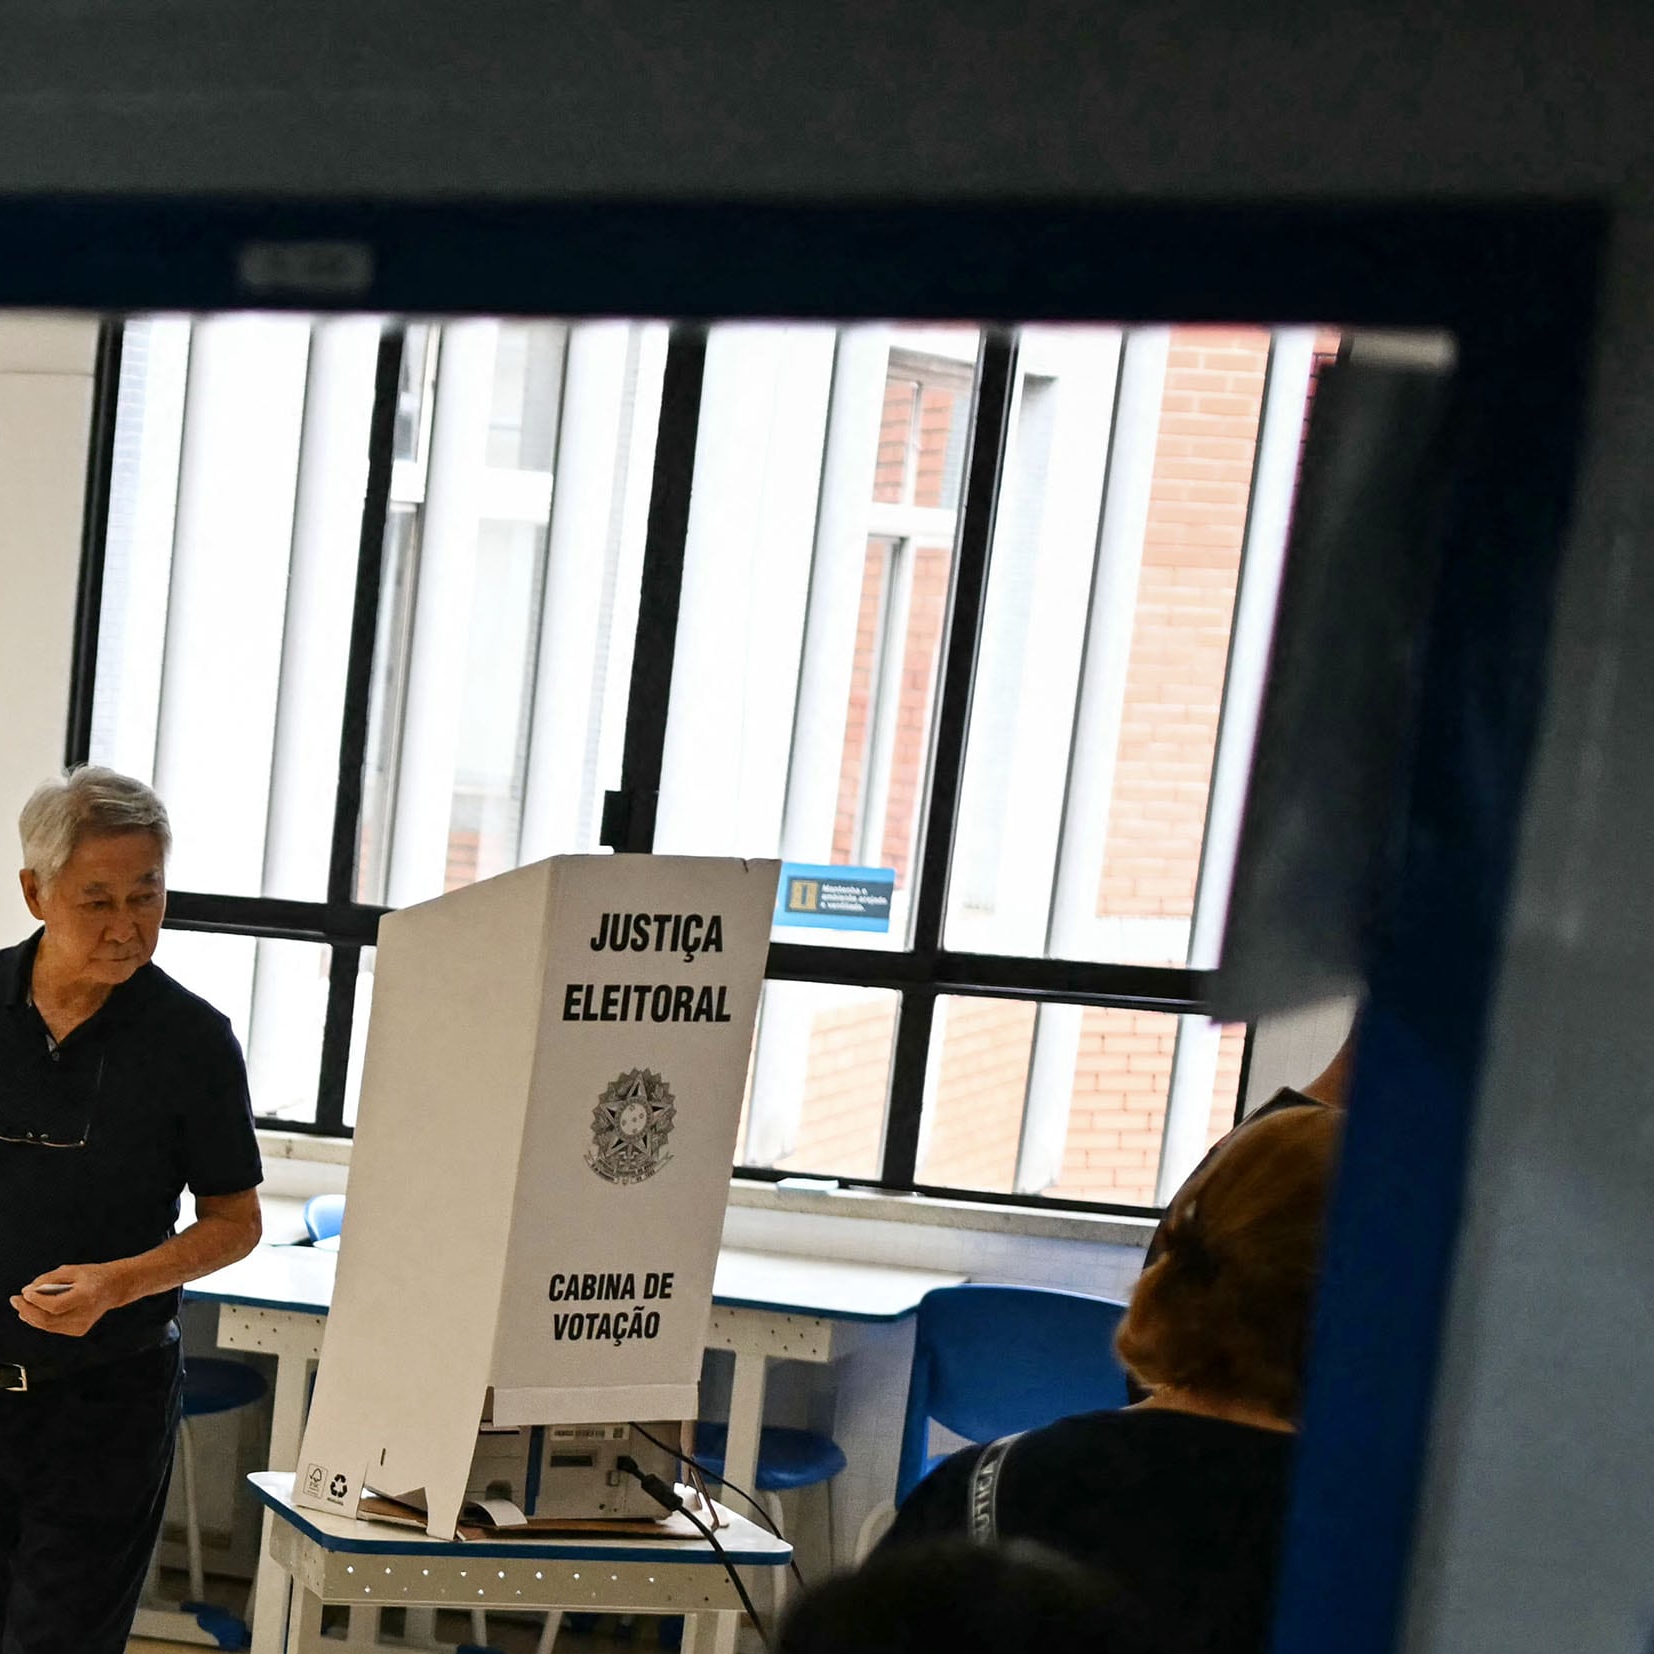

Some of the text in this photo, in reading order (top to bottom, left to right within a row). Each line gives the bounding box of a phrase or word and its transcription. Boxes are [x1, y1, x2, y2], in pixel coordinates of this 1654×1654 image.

[590, 913, 724, 962] JUSTIÇA
[563, 984, 732, 1023] ELEITORAL
[549, 1272, 674, 1301] CABINA DE
[553, 1306, 661, 1348] VOTAÇÃO
